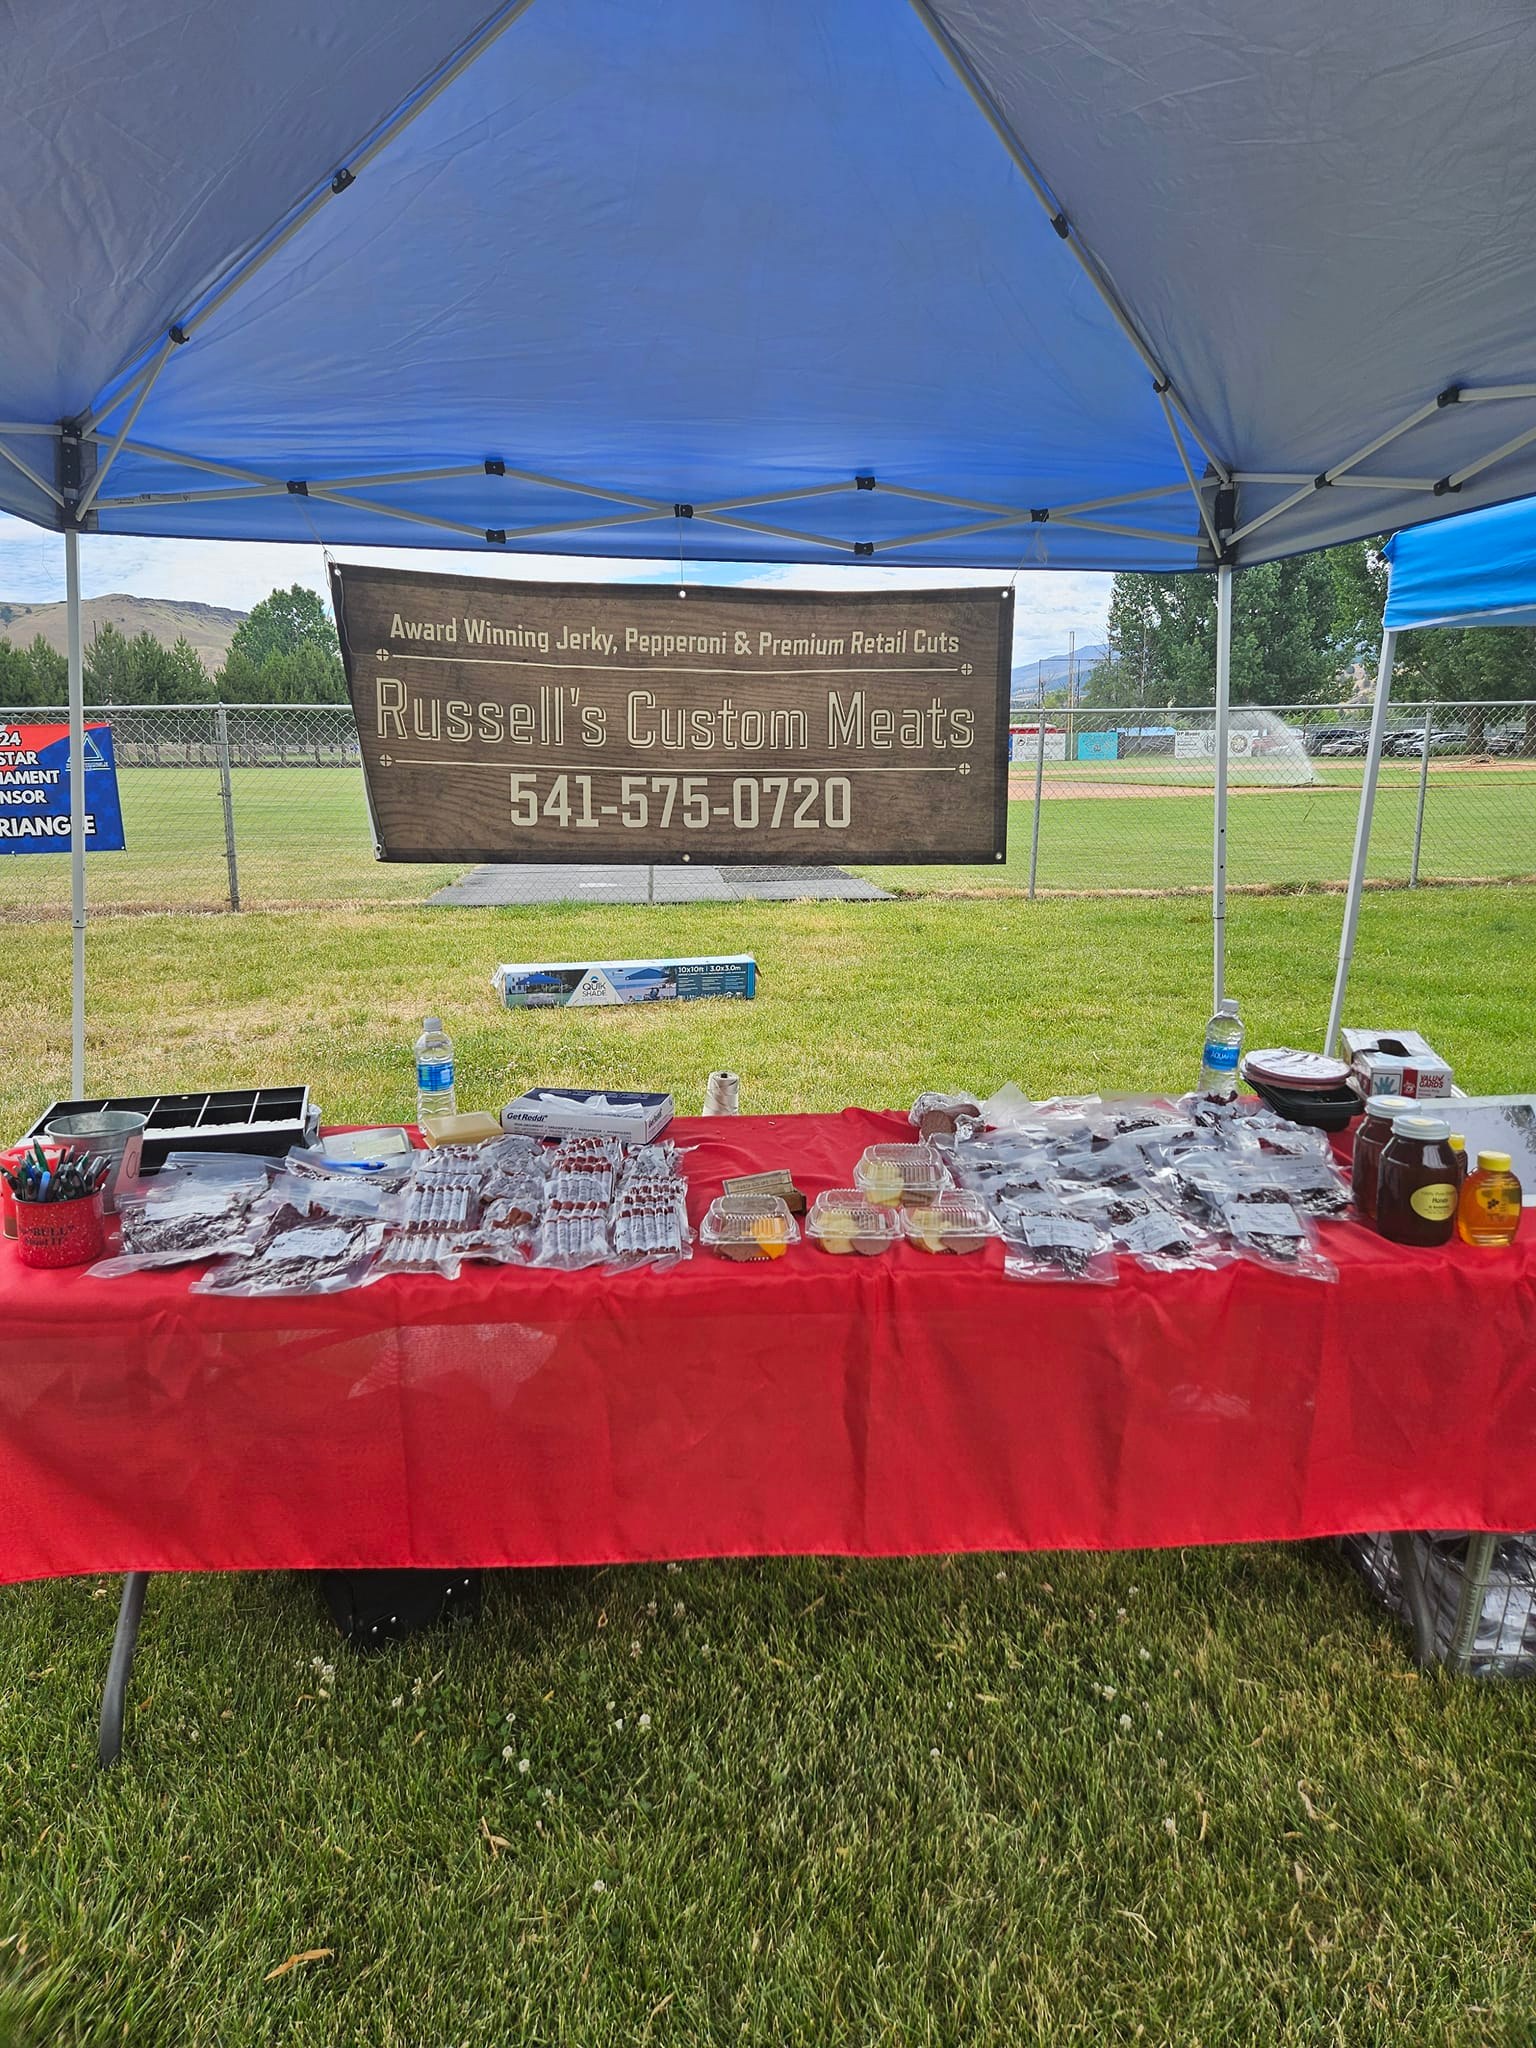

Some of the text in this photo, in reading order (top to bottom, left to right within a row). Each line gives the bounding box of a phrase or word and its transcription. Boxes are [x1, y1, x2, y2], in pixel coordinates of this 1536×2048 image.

[390, 613, 959, 656] Award Winning Jerky, Pepperoni & Premium Retail Cuts
[375, 677, 975, 750] Russell's Custom Meats
[0, 751, 39, 765] STAR
[510, 773, 851, 829] 541-575-0720
[0, 815, 96, 837] RIANGE
